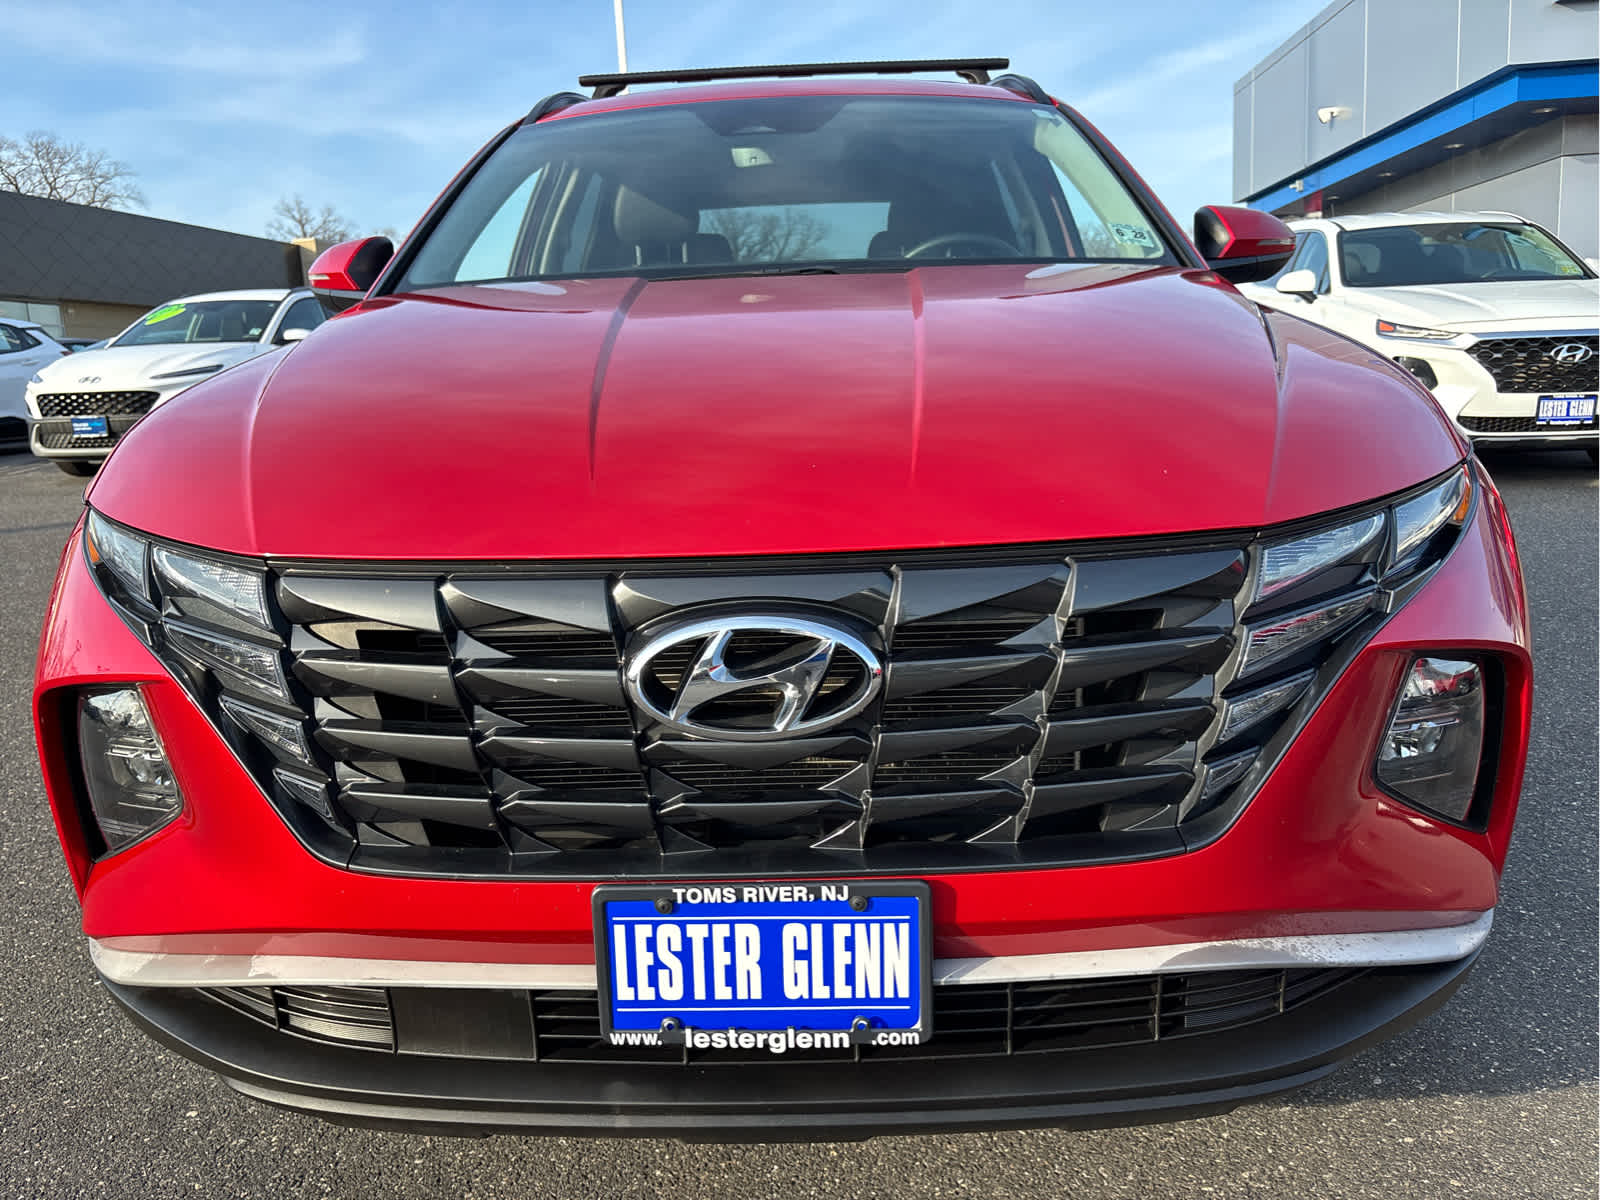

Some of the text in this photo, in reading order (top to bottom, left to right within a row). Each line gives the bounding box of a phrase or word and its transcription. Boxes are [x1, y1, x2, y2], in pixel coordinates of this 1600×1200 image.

[1538, 400, 1594, 417] LESTER GLENN
[672, 885, 849, 904] TOMS RIVER, NJ
[613, 922, 910, 1001] LESTER GLENN
[609, 1028, 920, 1053] www. lesterglenn .com
